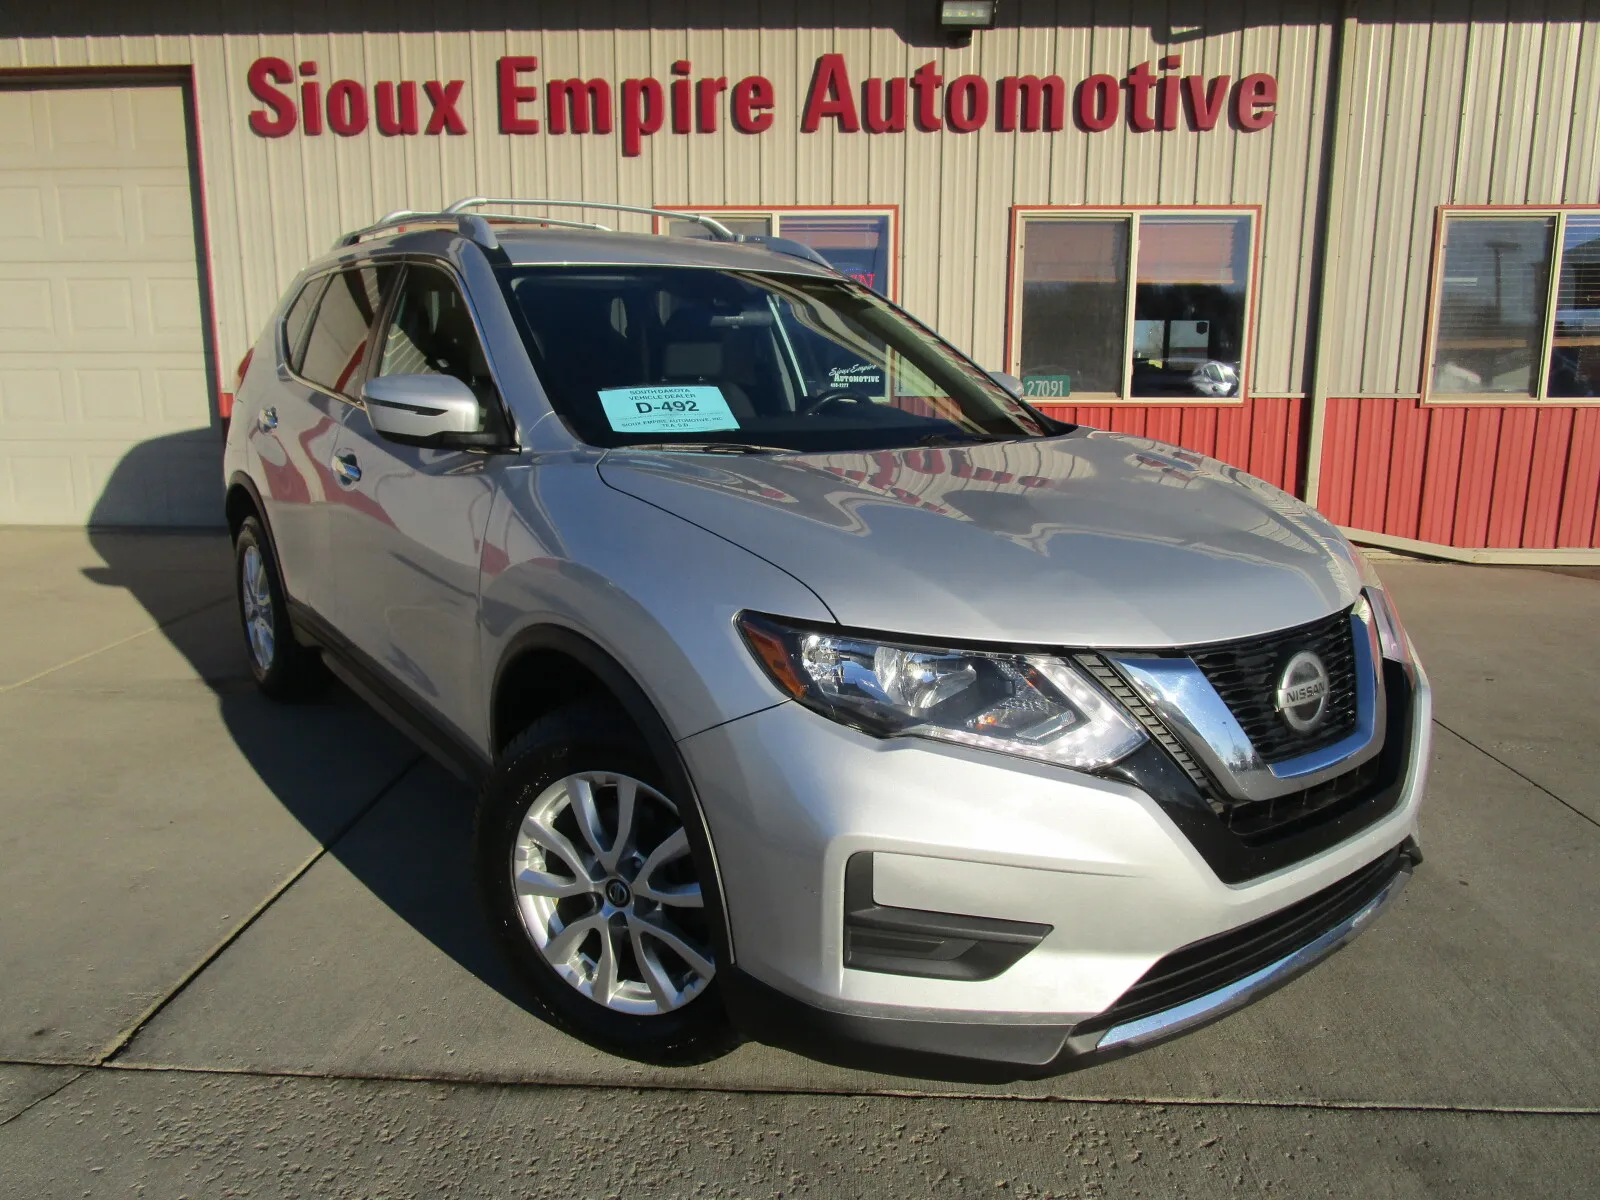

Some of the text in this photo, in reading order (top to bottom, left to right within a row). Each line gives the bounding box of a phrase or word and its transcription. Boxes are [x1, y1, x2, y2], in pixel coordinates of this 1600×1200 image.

[247, 53, 1278, 157] Sioux Empire Automotive
[1026, 380, 1064, 397] 27091
[635, 400, 700, 414] D-492
[1286, 682, 1325, 703] NISSAN
